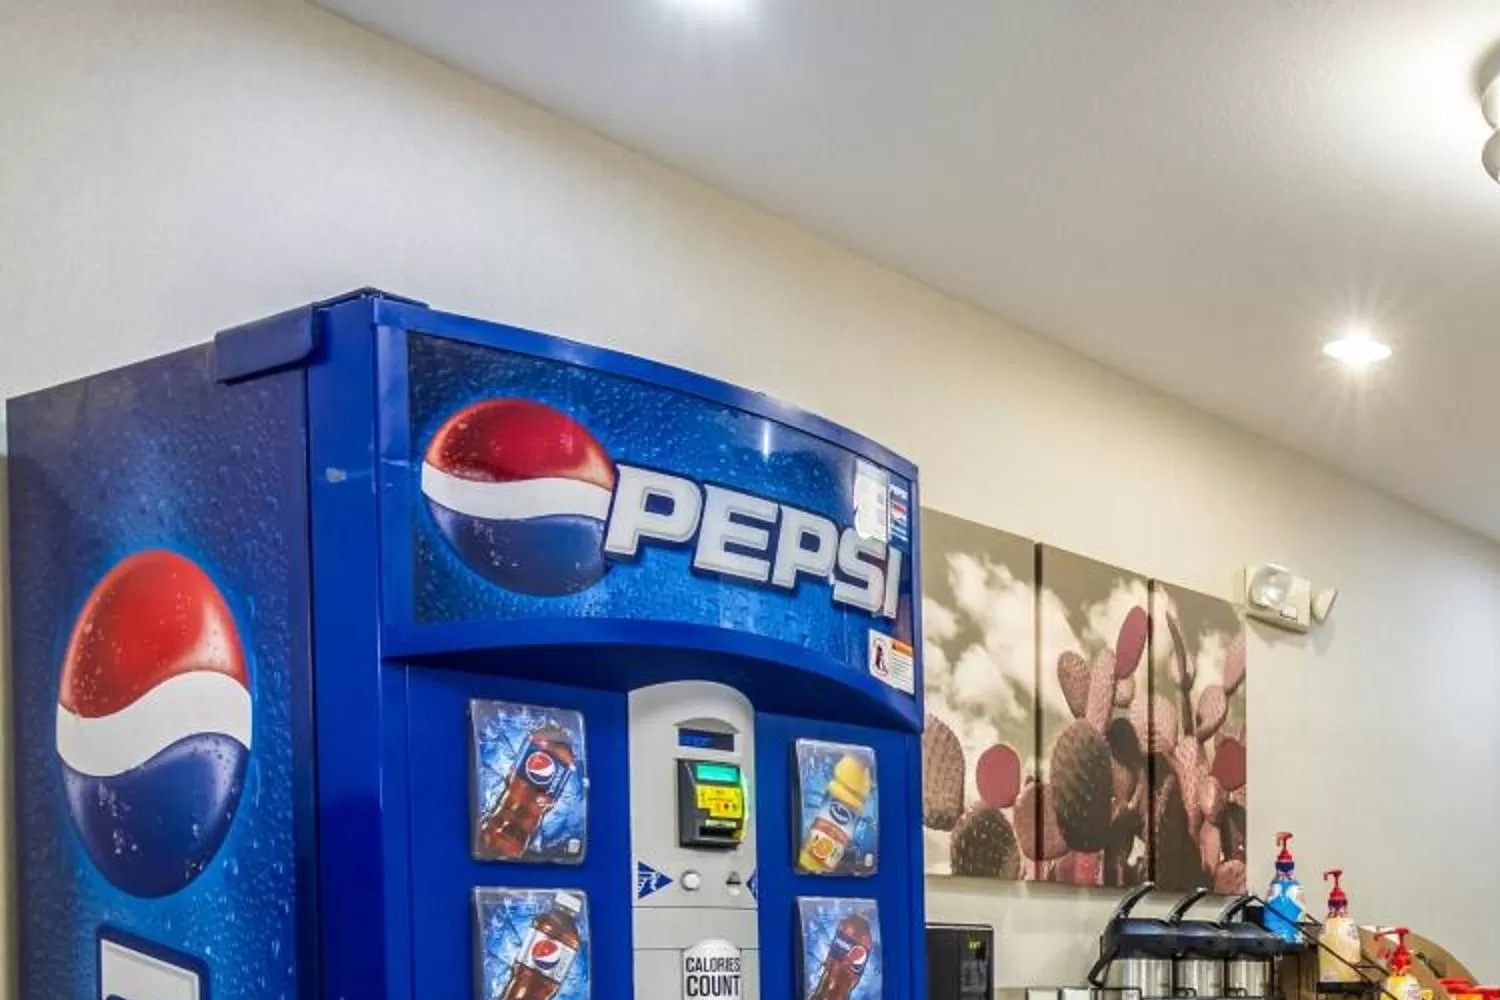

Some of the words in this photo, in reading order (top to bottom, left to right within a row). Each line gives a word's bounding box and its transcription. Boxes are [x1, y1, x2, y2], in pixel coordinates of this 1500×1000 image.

[604, 463, 902, 619] PEPSI
[685, 957, 741, 972] CALORIES
[686, 975, 741, 997] COUNT
